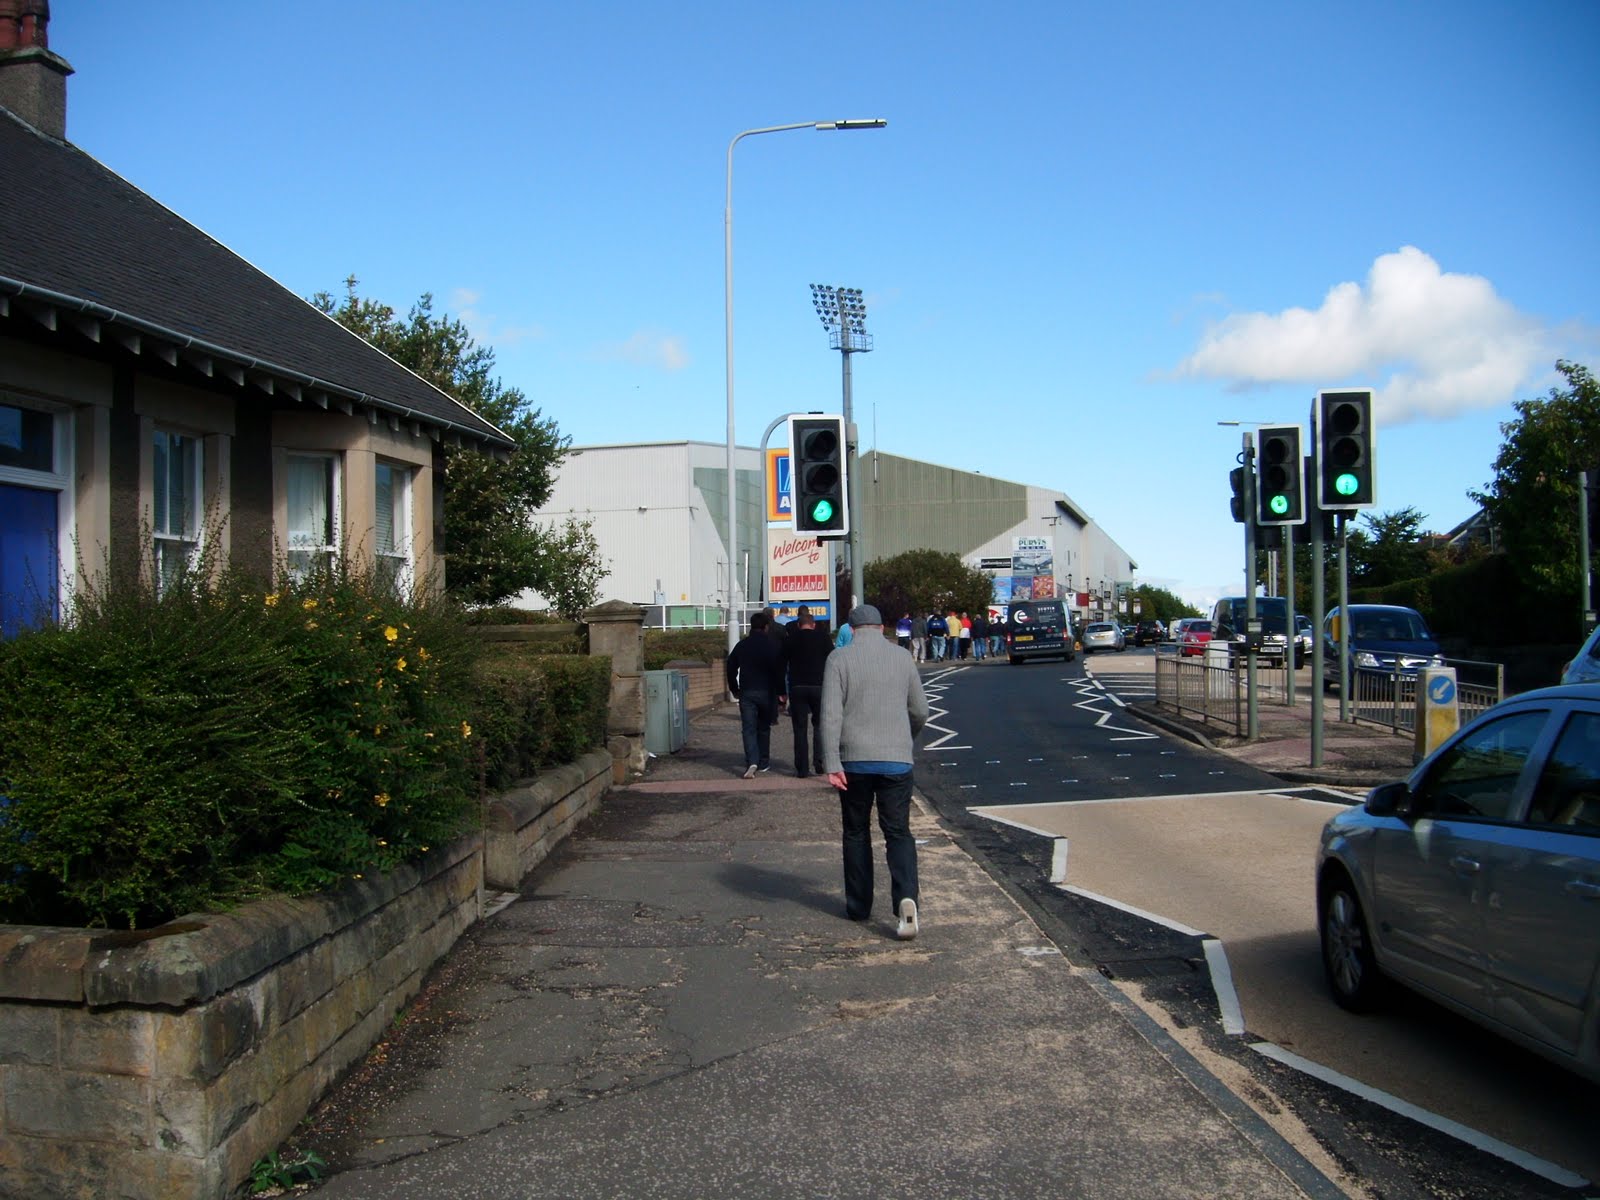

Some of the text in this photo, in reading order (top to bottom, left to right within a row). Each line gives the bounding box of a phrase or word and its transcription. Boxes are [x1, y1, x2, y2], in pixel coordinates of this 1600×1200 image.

[773, 539, 822, 560] Welcom
[808, 549, 820, 564] to
[776, 582, 824, 592] ICELAND
